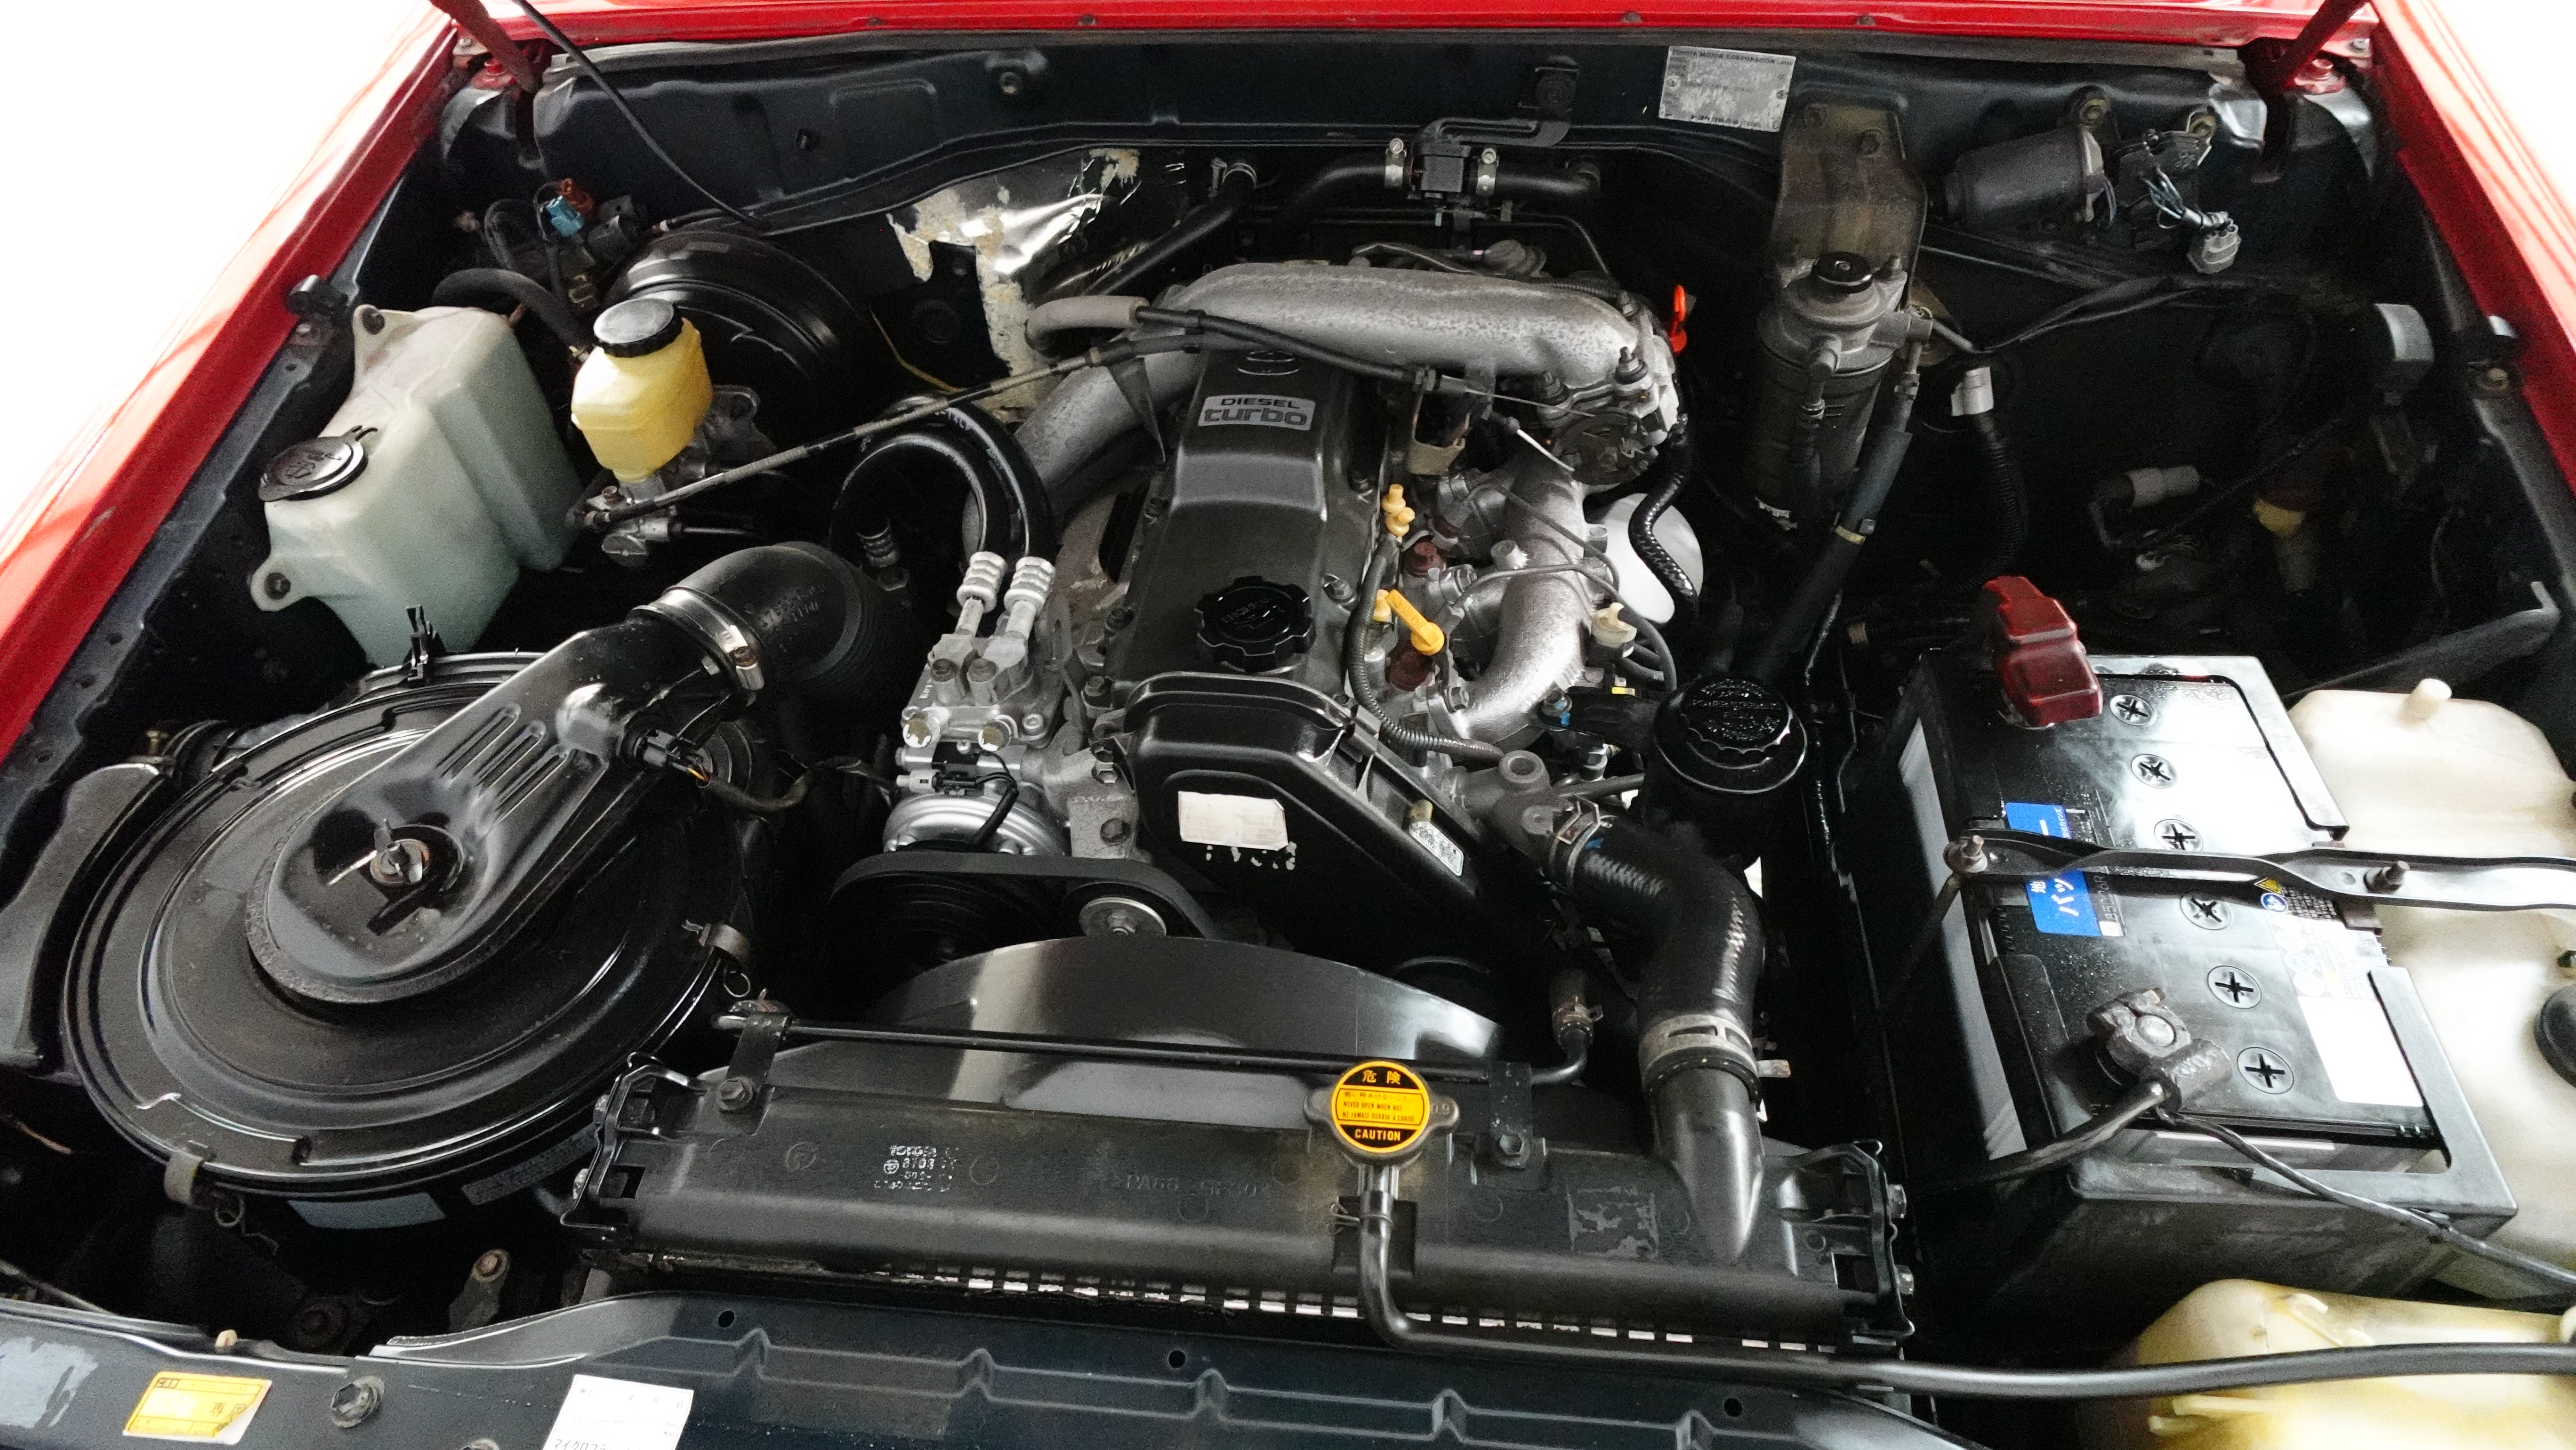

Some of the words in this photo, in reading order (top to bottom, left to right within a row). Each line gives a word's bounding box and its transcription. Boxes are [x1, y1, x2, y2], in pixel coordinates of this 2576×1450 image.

[1726, 54, 1775, 64] CORPORATION
[1221, 397, 1300, 409] DIESEL
[1205, 408, 1307, 425] turbo
[1362, 1070, 1401, 1085] 危険
[1355, 1128, 1401, 1141] CAUTION
[652, 1397, 660, 1405] 月
[676, 1401, 684, 1409] 日
